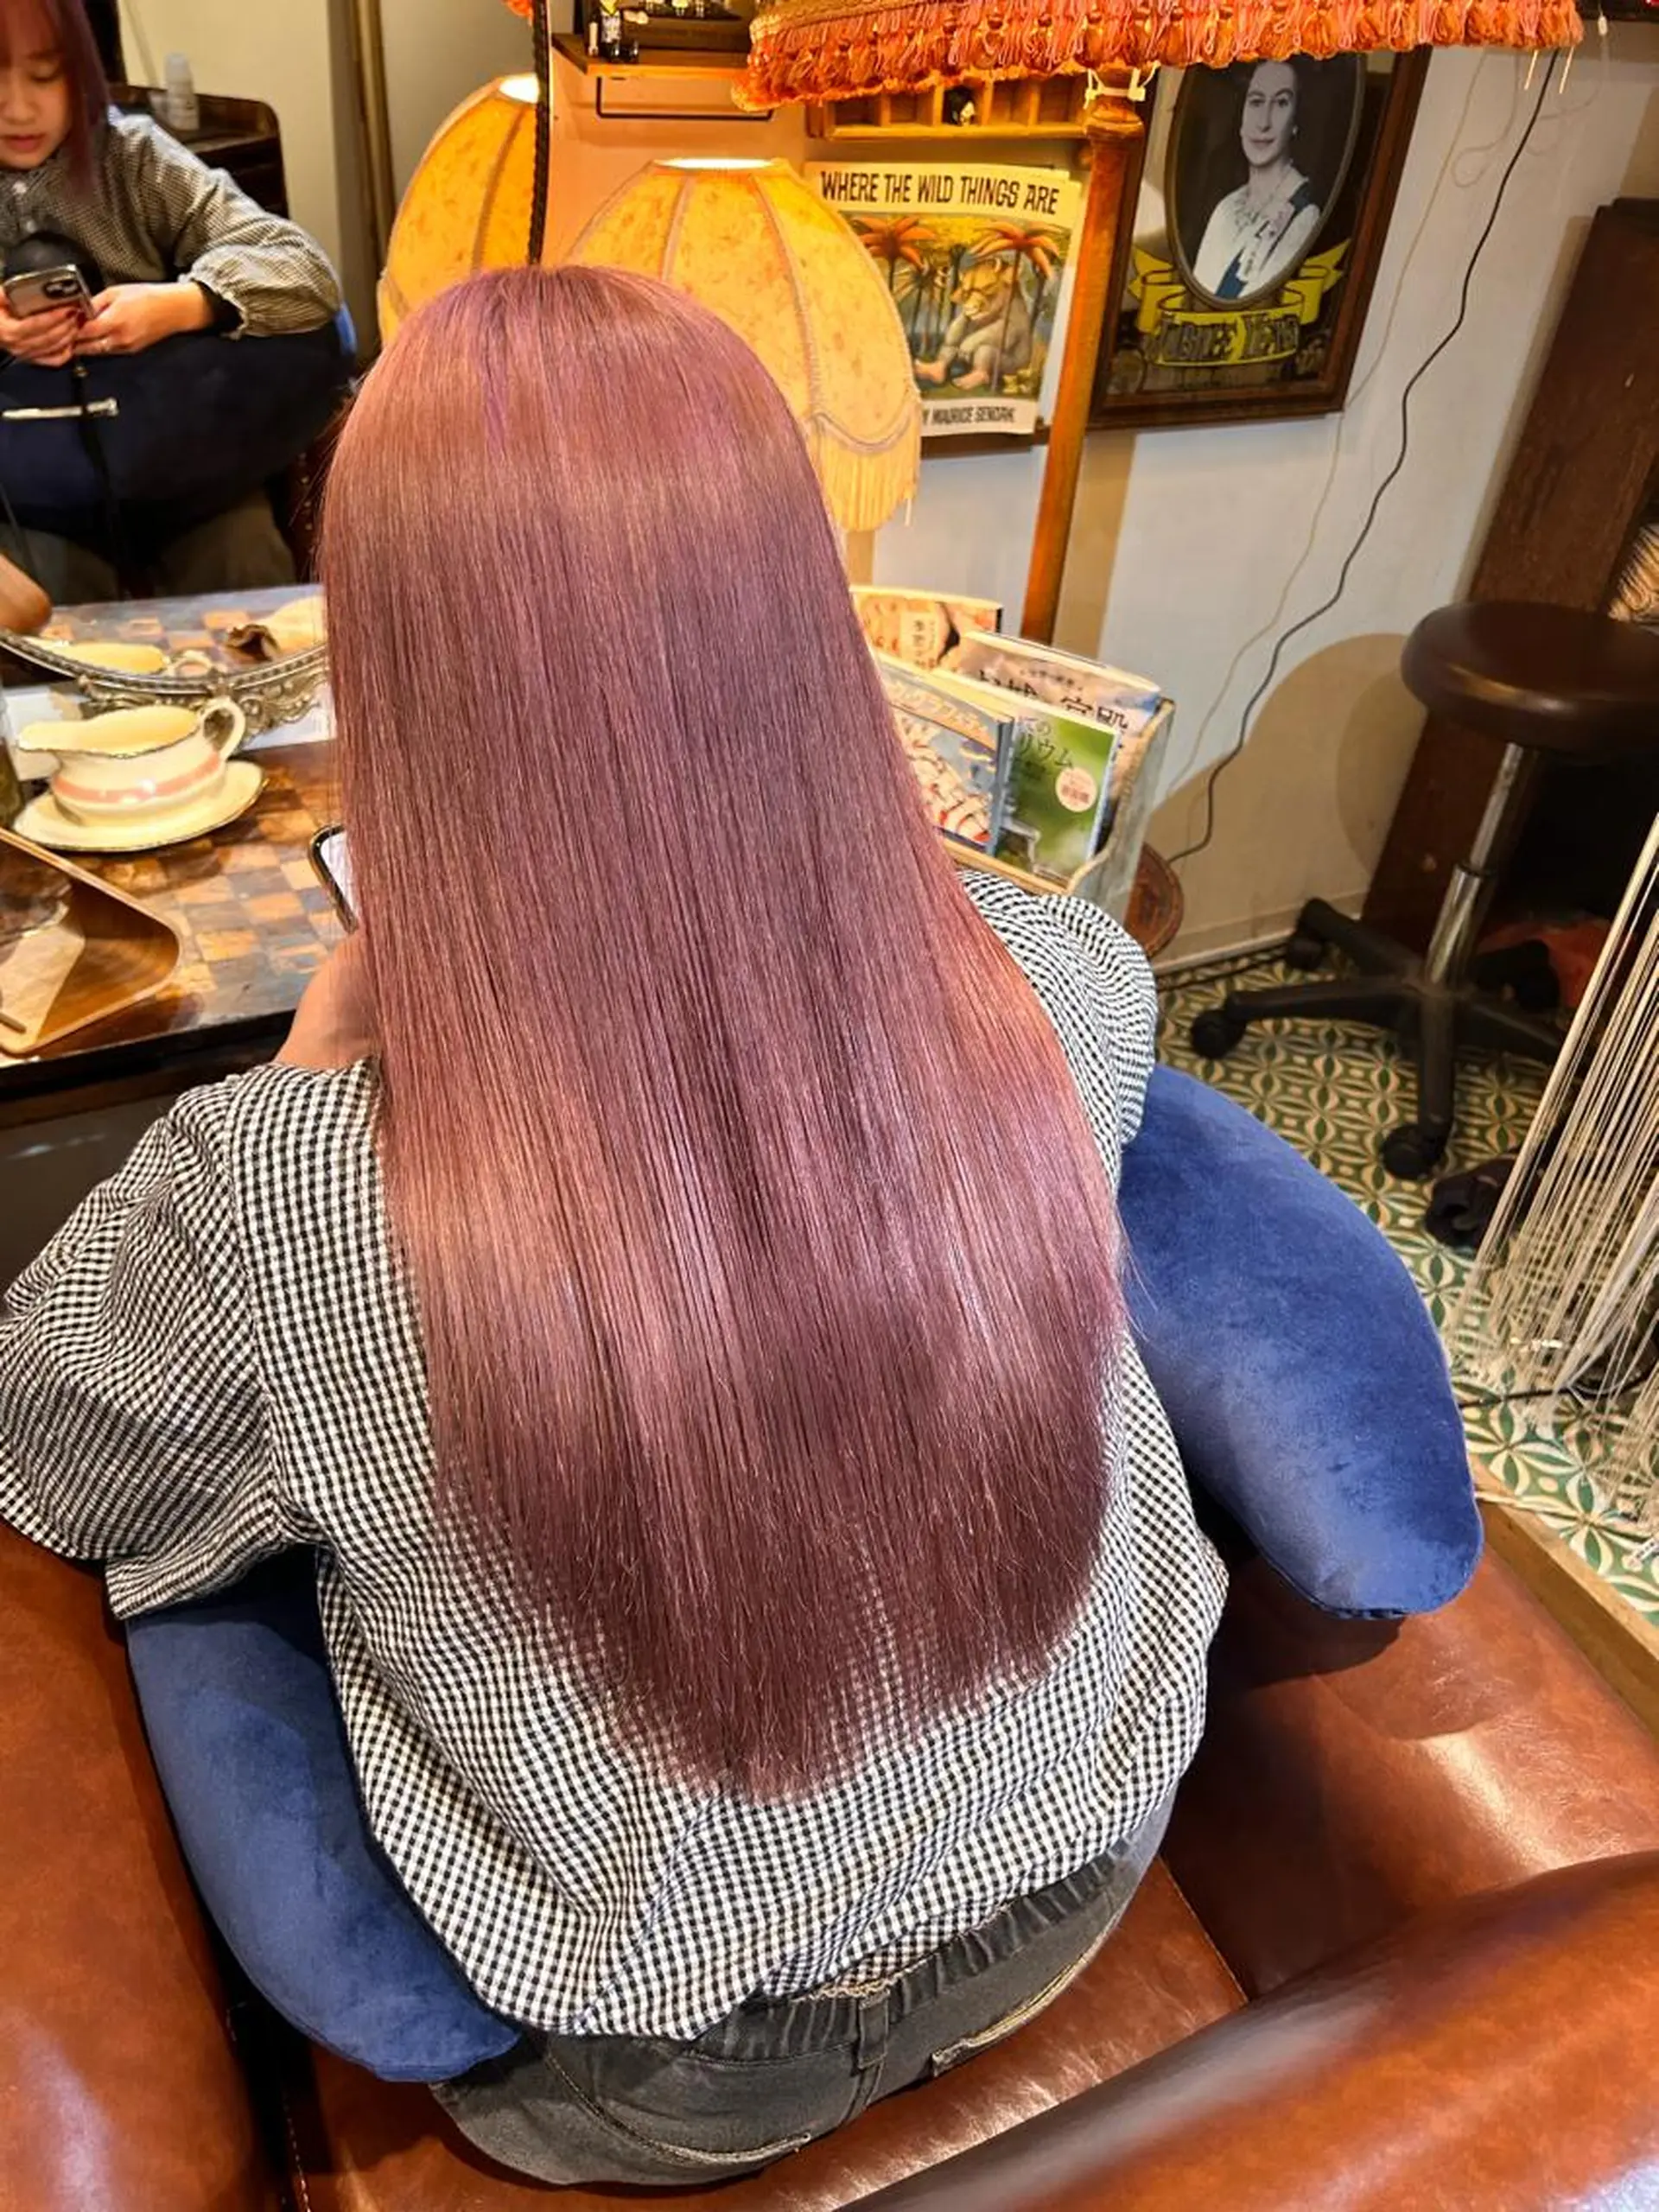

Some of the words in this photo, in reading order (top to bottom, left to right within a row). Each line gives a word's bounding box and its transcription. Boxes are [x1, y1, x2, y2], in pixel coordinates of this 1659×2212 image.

[821, 171, 880, 202] WHERE
[884, 174, 912, 202] THE
[917, 175, 954, 203] WILD
[960, 175, 1020, 207] THINGS
[1023, 184, 1060, 214] ARE
